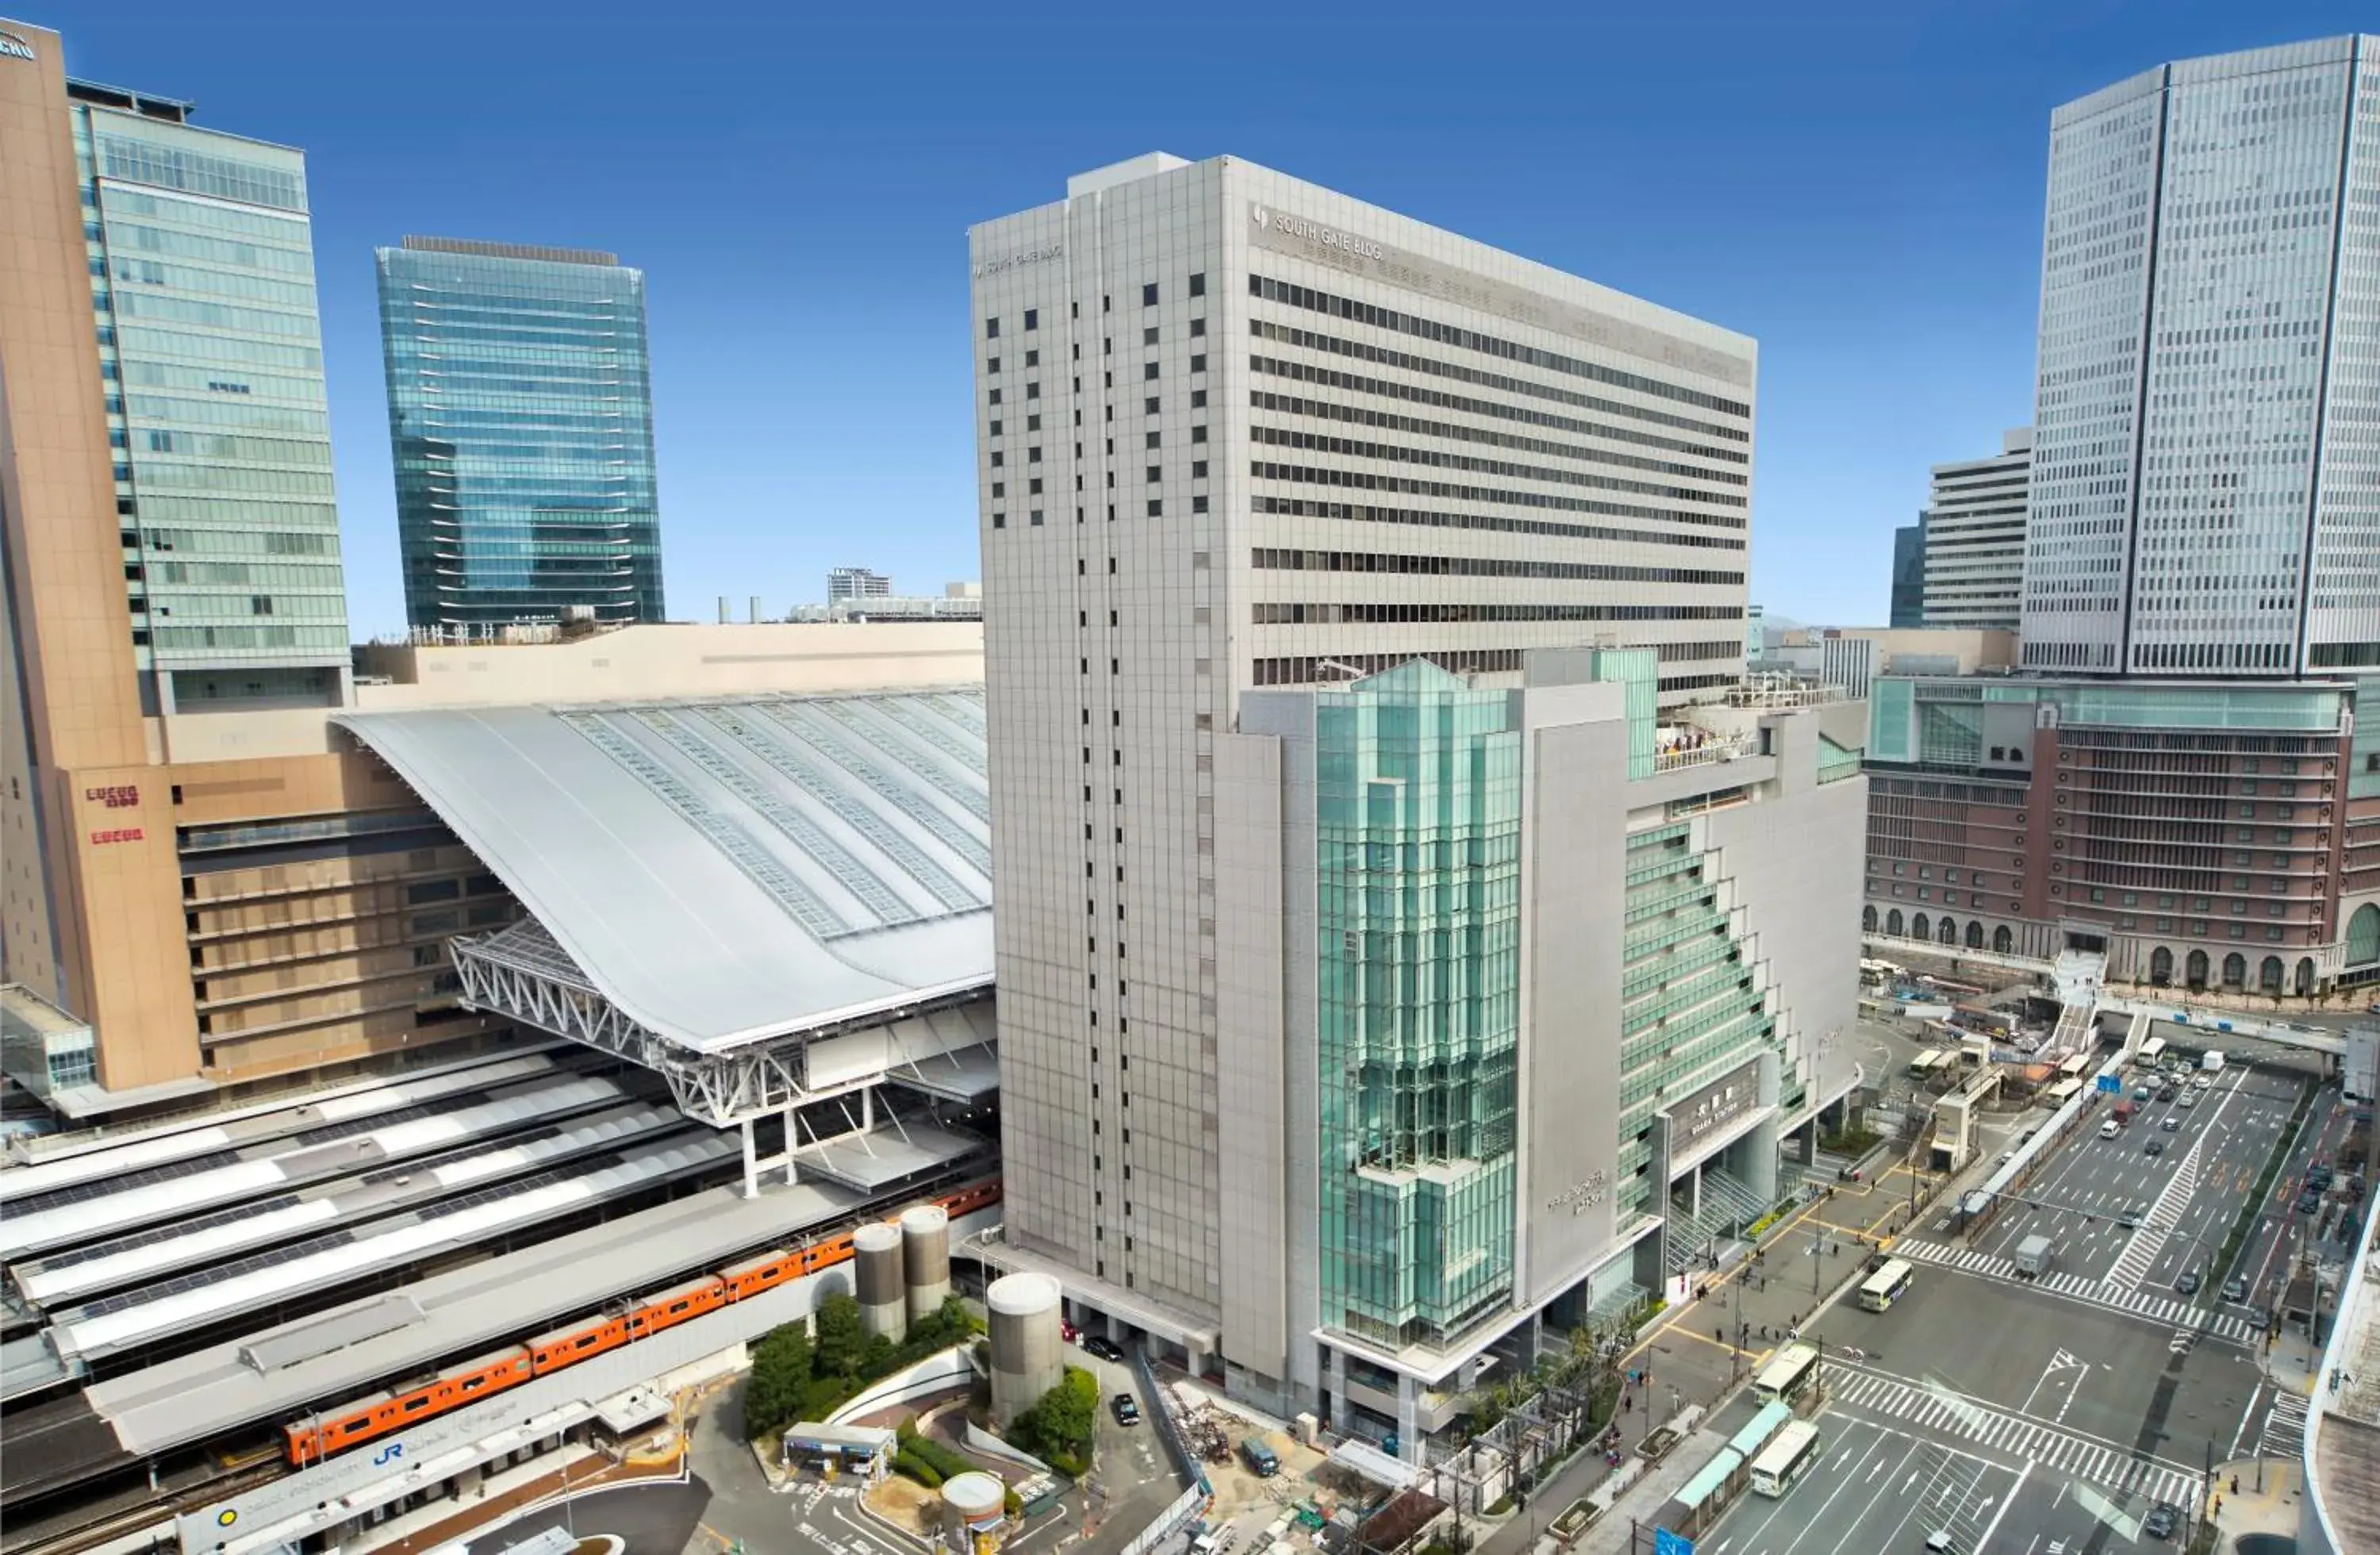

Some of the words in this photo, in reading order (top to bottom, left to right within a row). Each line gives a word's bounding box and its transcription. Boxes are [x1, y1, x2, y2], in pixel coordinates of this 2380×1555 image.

[1275, 215, 1317, 240] SOUTH
[1321, 228, 1349, 251] GATE
[86, 785, 139, 801] LUCUA
[91, 828, 144, 845] LUCUA
[374, 1443, 402, 1466] JR
